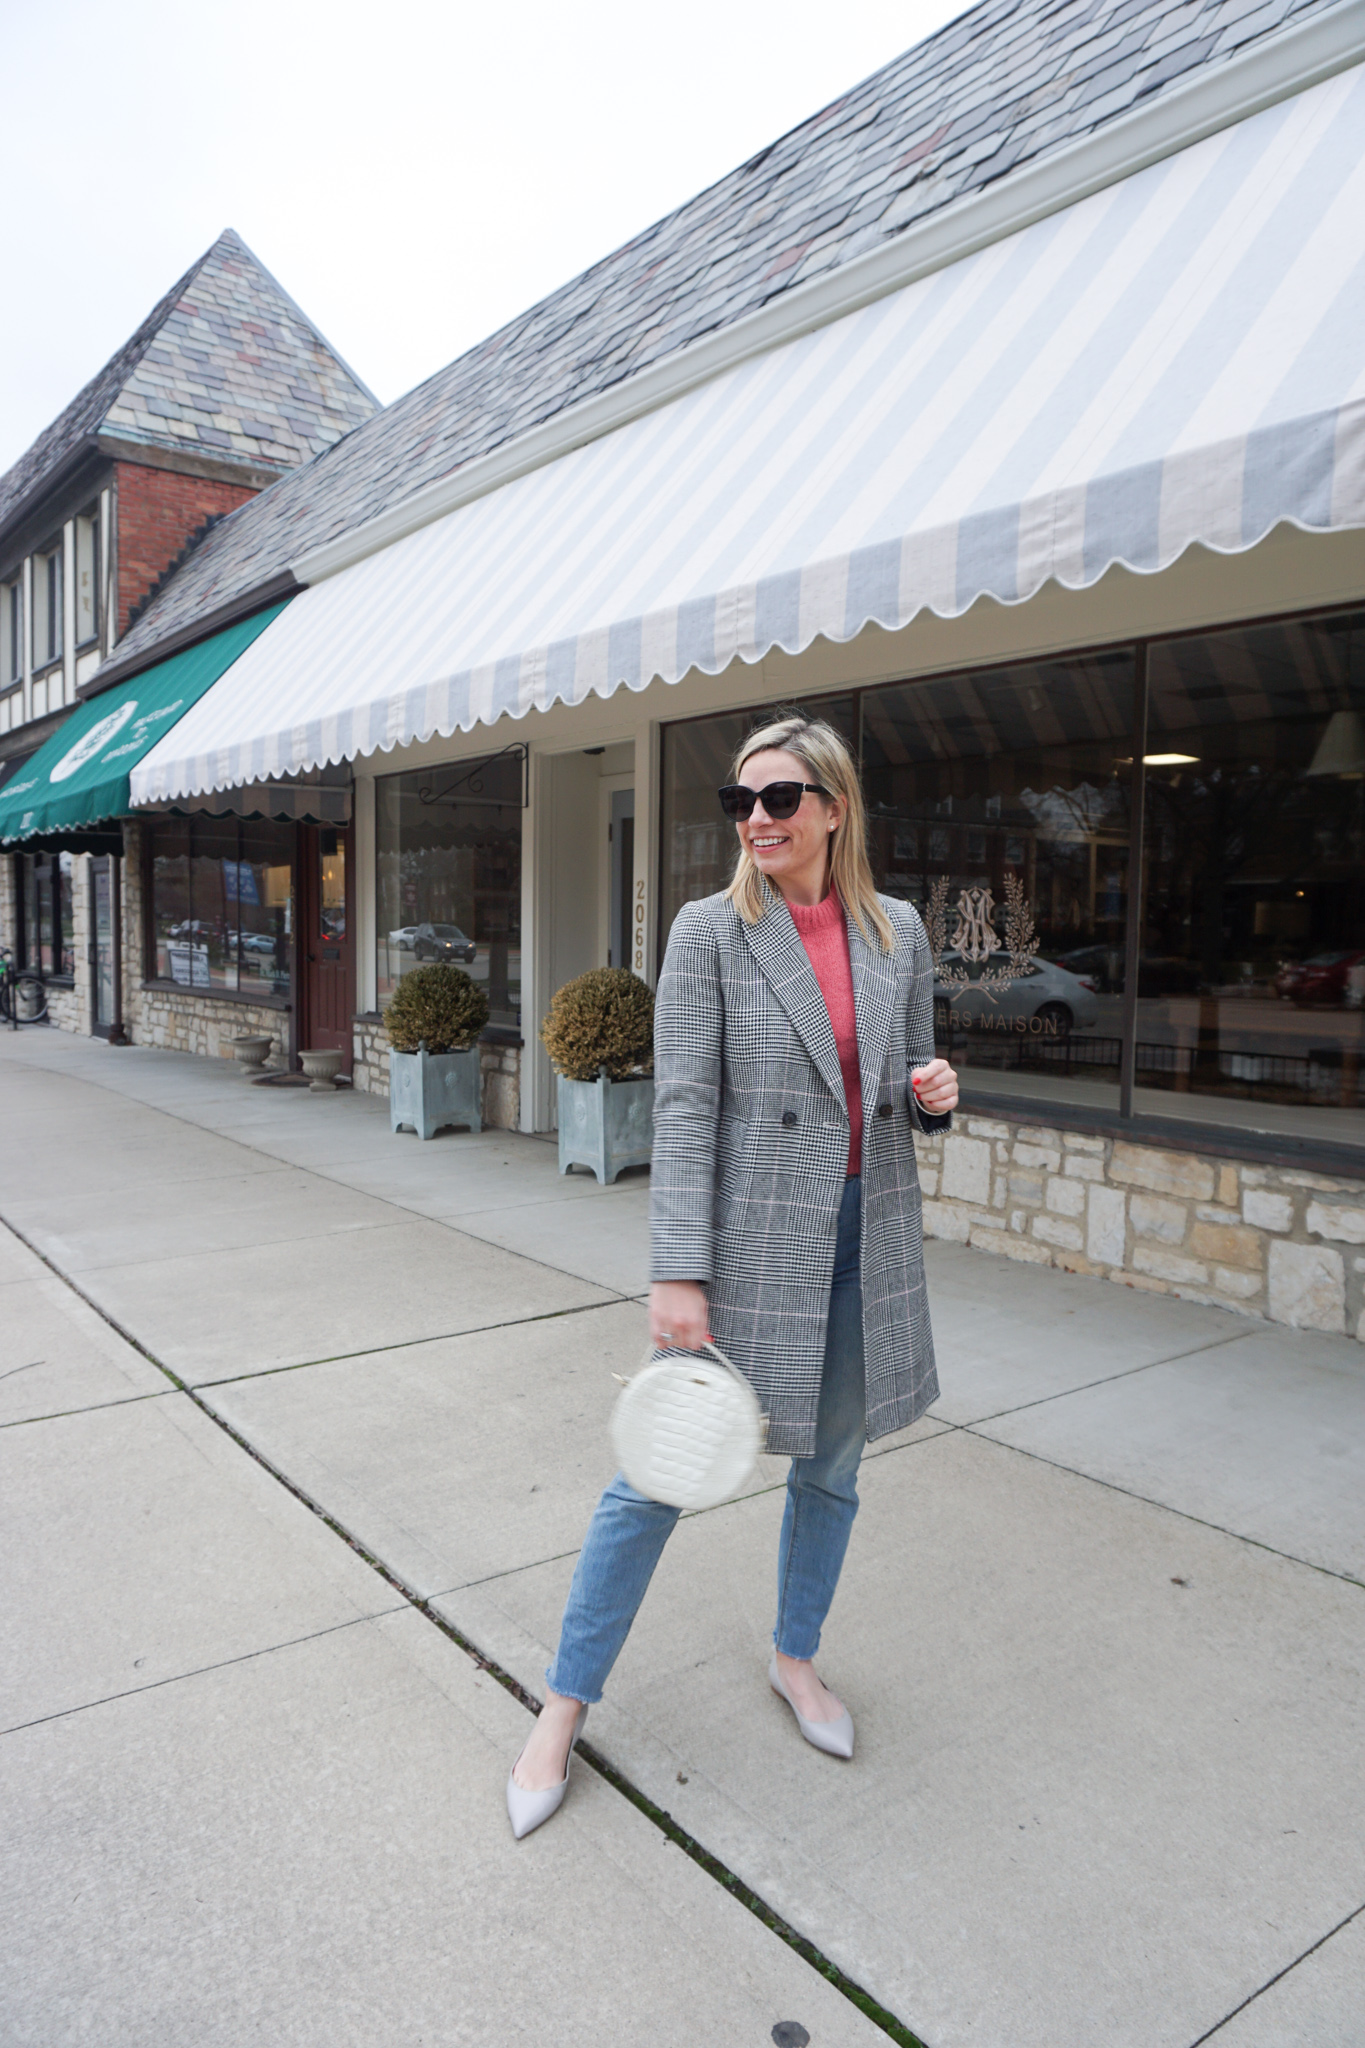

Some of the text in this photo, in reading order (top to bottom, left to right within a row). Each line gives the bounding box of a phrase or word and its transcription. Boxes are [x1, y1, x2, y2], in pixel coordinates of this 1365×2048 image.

[635, 880, 645, 970] 2068
[934, 1008, 1058, 1035] ERS MAISON
